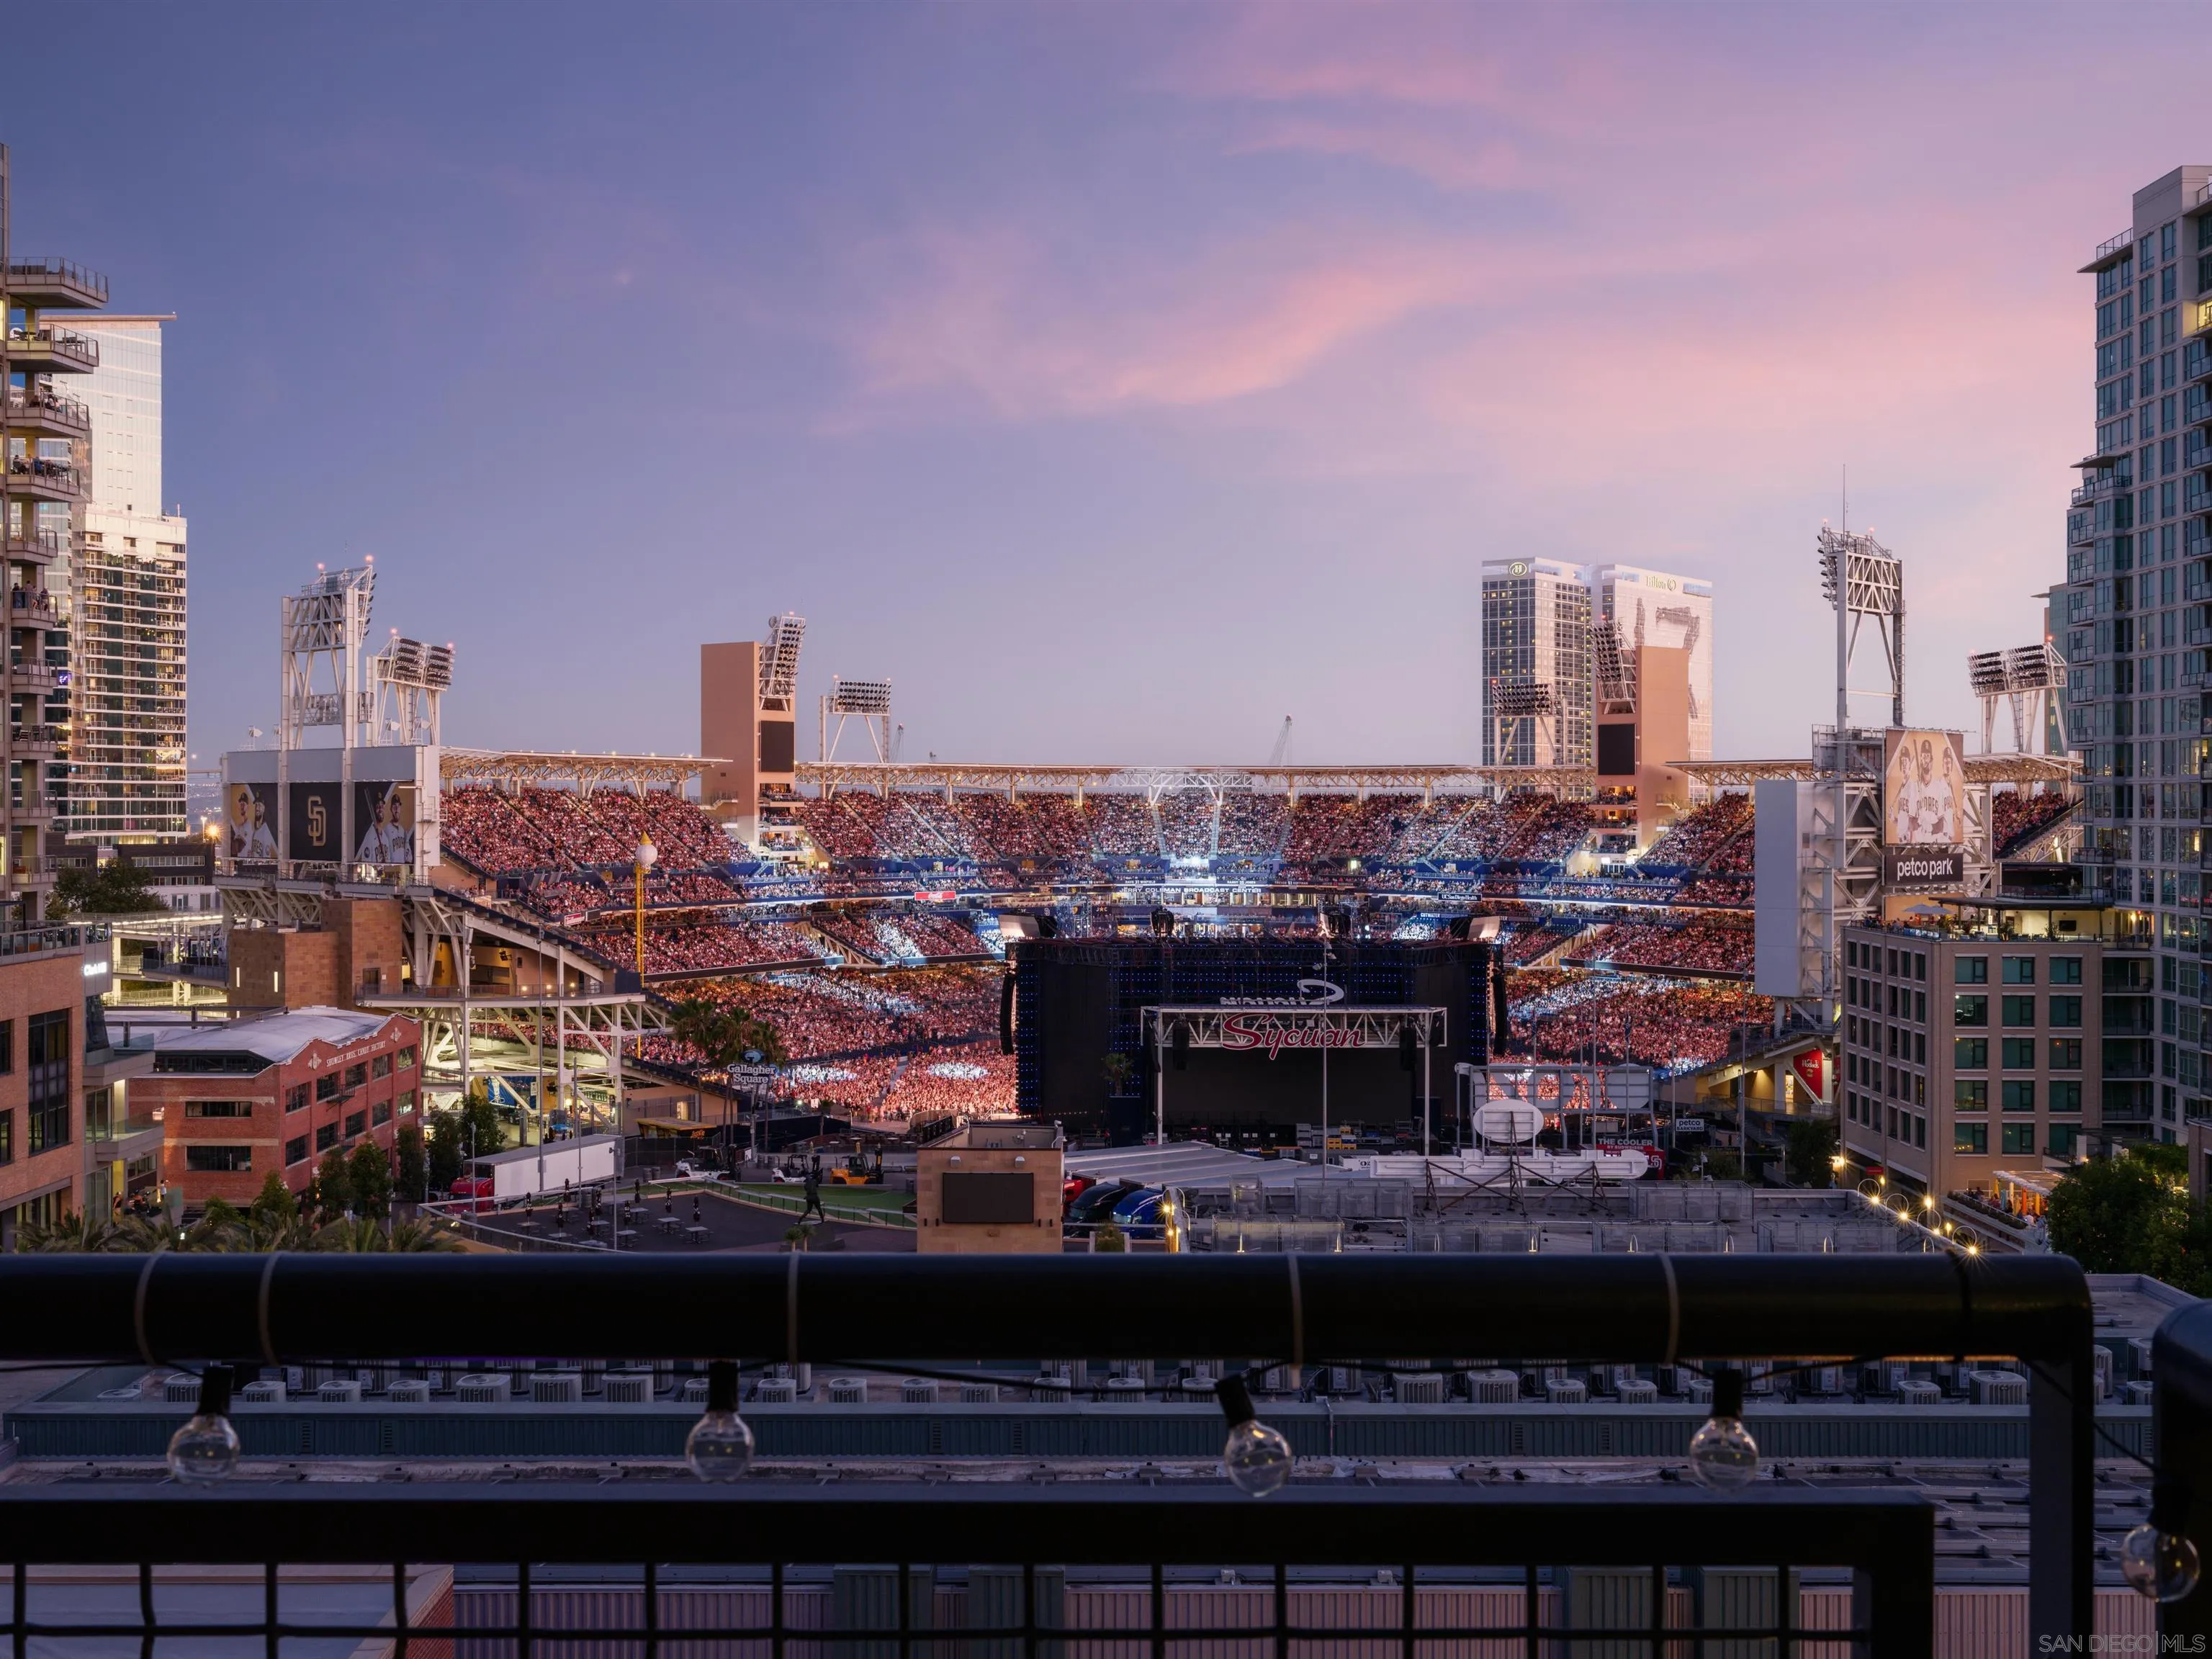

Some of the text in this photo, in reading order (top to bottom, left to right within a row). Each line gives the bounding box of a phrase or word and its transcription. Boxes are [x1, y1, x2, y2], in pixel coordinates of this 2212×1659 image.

[1897, 857, 1953, 881] petco park
[1221, 1012, 1367, 1061] Sycuan
[326, 1054, 344, 1067] SHOWLEY
[357, 1046, 369, 1056] CANDY
[371, 1040, 386, 1052] FACTORY
[727, 1064, 775, 1076] Gallagher
[733, 1074, 768, 1084] Square
